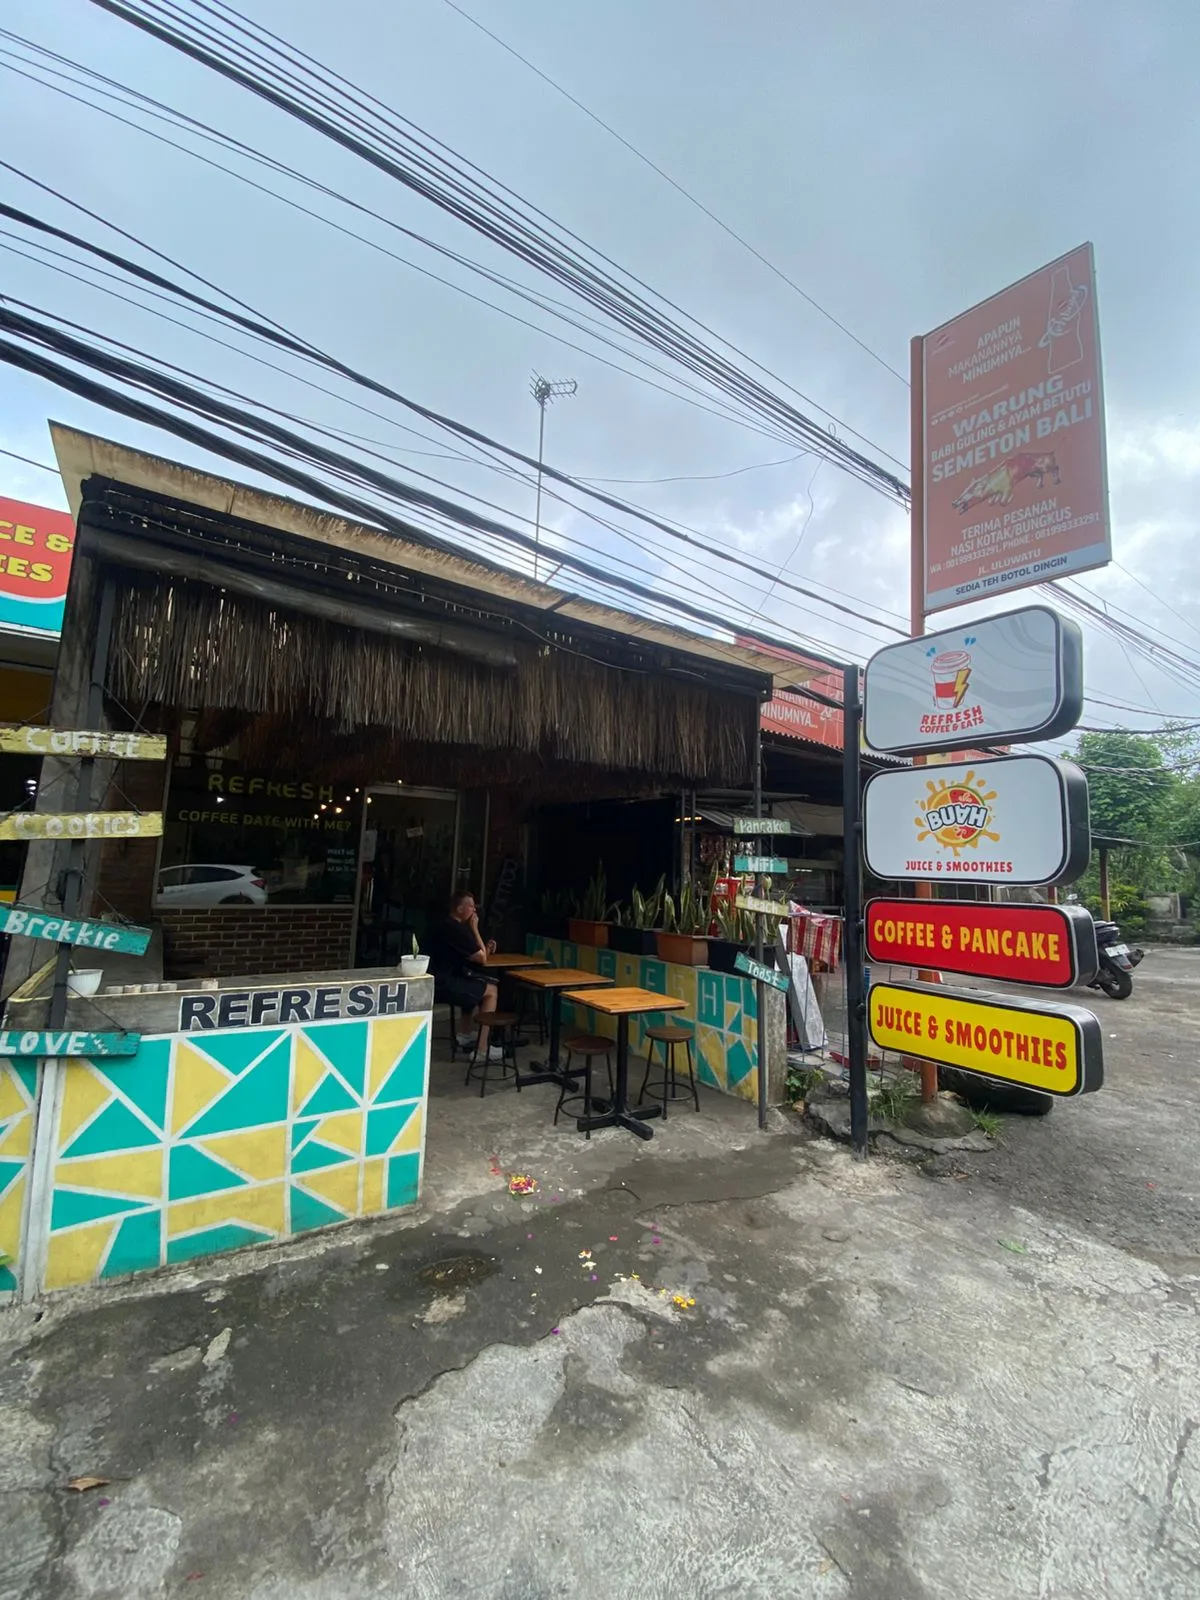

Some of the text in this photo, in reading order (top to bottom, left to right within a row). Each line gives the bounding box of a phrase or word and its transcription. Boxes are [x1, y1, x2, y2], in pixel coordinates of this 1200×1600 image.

[977, 316, 1020, 349] APAPUN
[948, 331, 1023, 378] MAKANANNYA
[931, 444, 955, 462] BABI
[956, 424, 996, 450] GULING
[997, 420, 1006, 432] &
[1008, 403, 1040, 428] AYAM
[1043, 380, 1092, 412] BETUTU
[952, 375, 1064, 438] WARUNG
[932, 424, 1031, 483] SEMETON
[1036, 398, 1093, 439] BALI
[951, 507, 1072, 557] NASI KOTAK/BUNGKUS
[961, 497, 1057, 541] TERIMA PESANAN
[46, 533, 73, 553] &
[991, 548, 1041, 570] ULUWATU
[1003, 535, 1030, 552] PHONE
[956, 555, 1068, 595] SEDIA TEH BOTOL DINGIN
[919, 723, 950, 733] COFFEE
[961, 716, 984, 730] EATS
[920, 705, 983, 725] REFRESH
[207, 773, 335, 801] REFRESH
[178, 809, 352, 832] COFFEE DATE WITH ME?
[739, 819, 785, 833] Pancake
[905, 860, 1013, 873] JUICE & SMOOTHIES
[3, 910, 121, 950] Brekkie
[873, 919, 1061, 962] COFFEE & PANCAKE
[178, 982, 409, 1032] REFRESH
[0, 1031, 89, 1055] LOVE
[876, 1004, 1068, 1071] JUICE & SMOOTHIES
